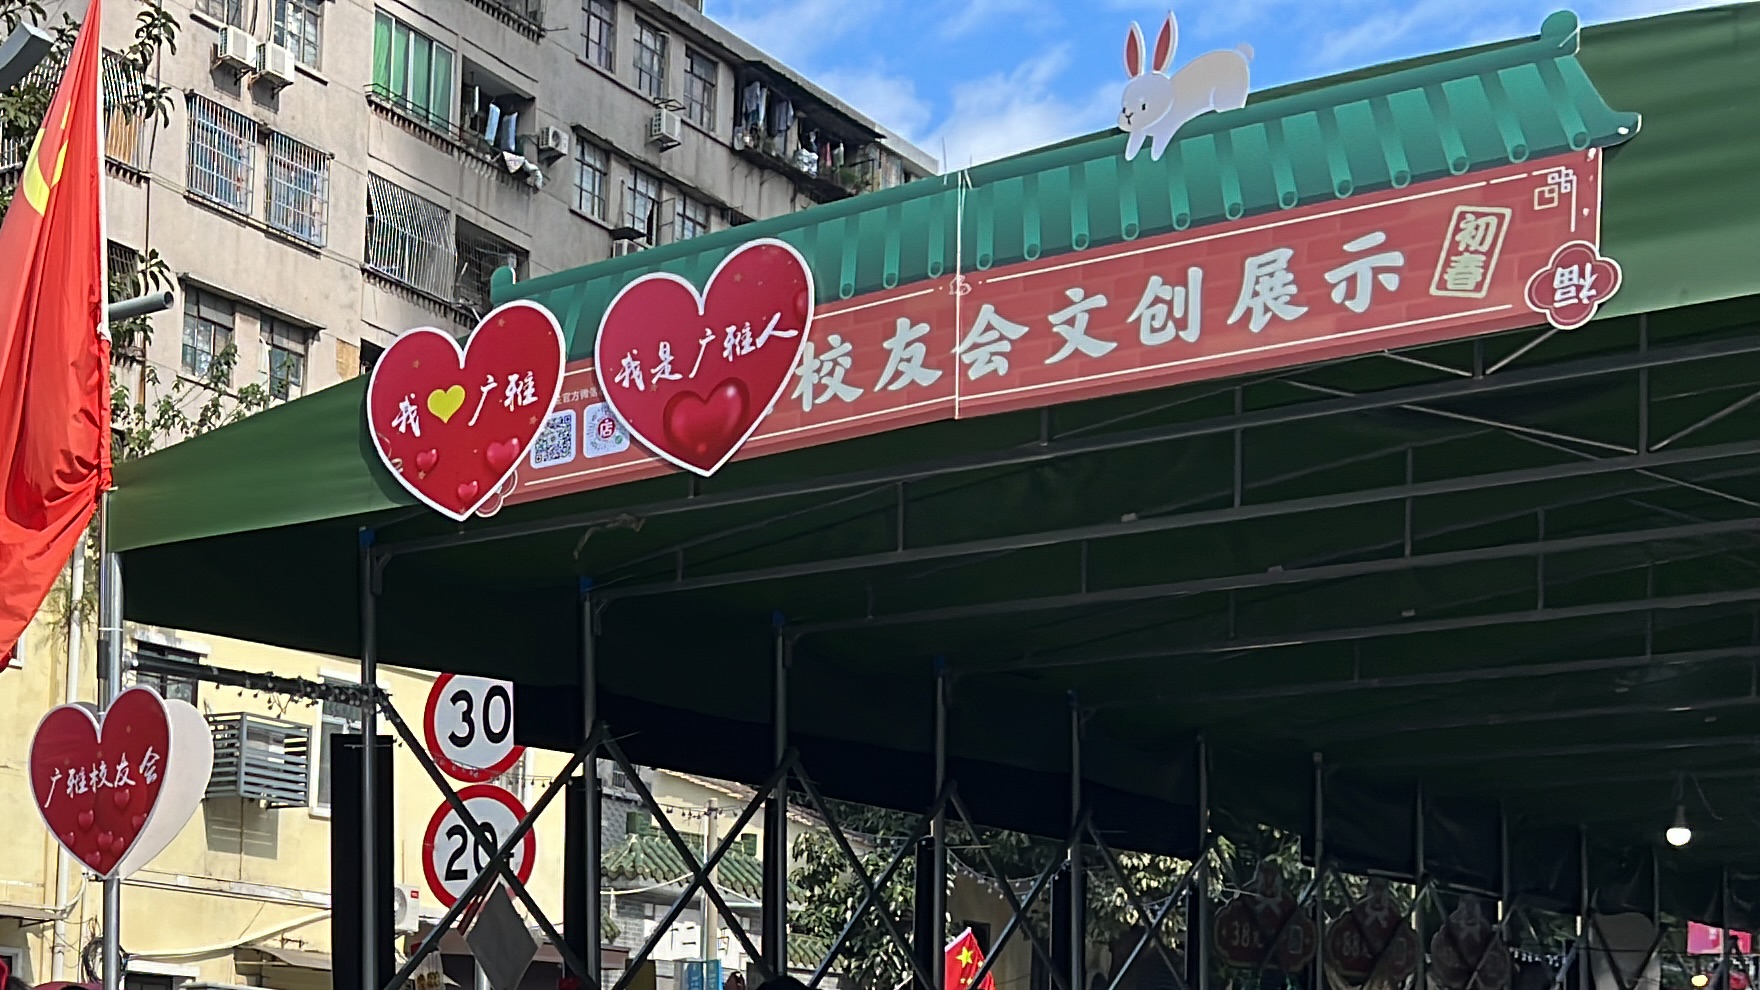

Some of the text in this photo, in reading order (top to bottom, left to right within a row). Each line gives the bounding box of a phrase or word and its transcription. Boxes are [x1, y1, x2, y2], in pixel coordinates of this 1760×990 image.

[1443, 212, 1498, 290] 初春
[614, 311, 798, 390] 我是广雅人
[791, 230, 1405, 413] 校友会文创展示
[467, 370, 539, 427] 广雅
[448, 684, 512, 748] 30
[44, 745, 161, 809] 广雅校友会
